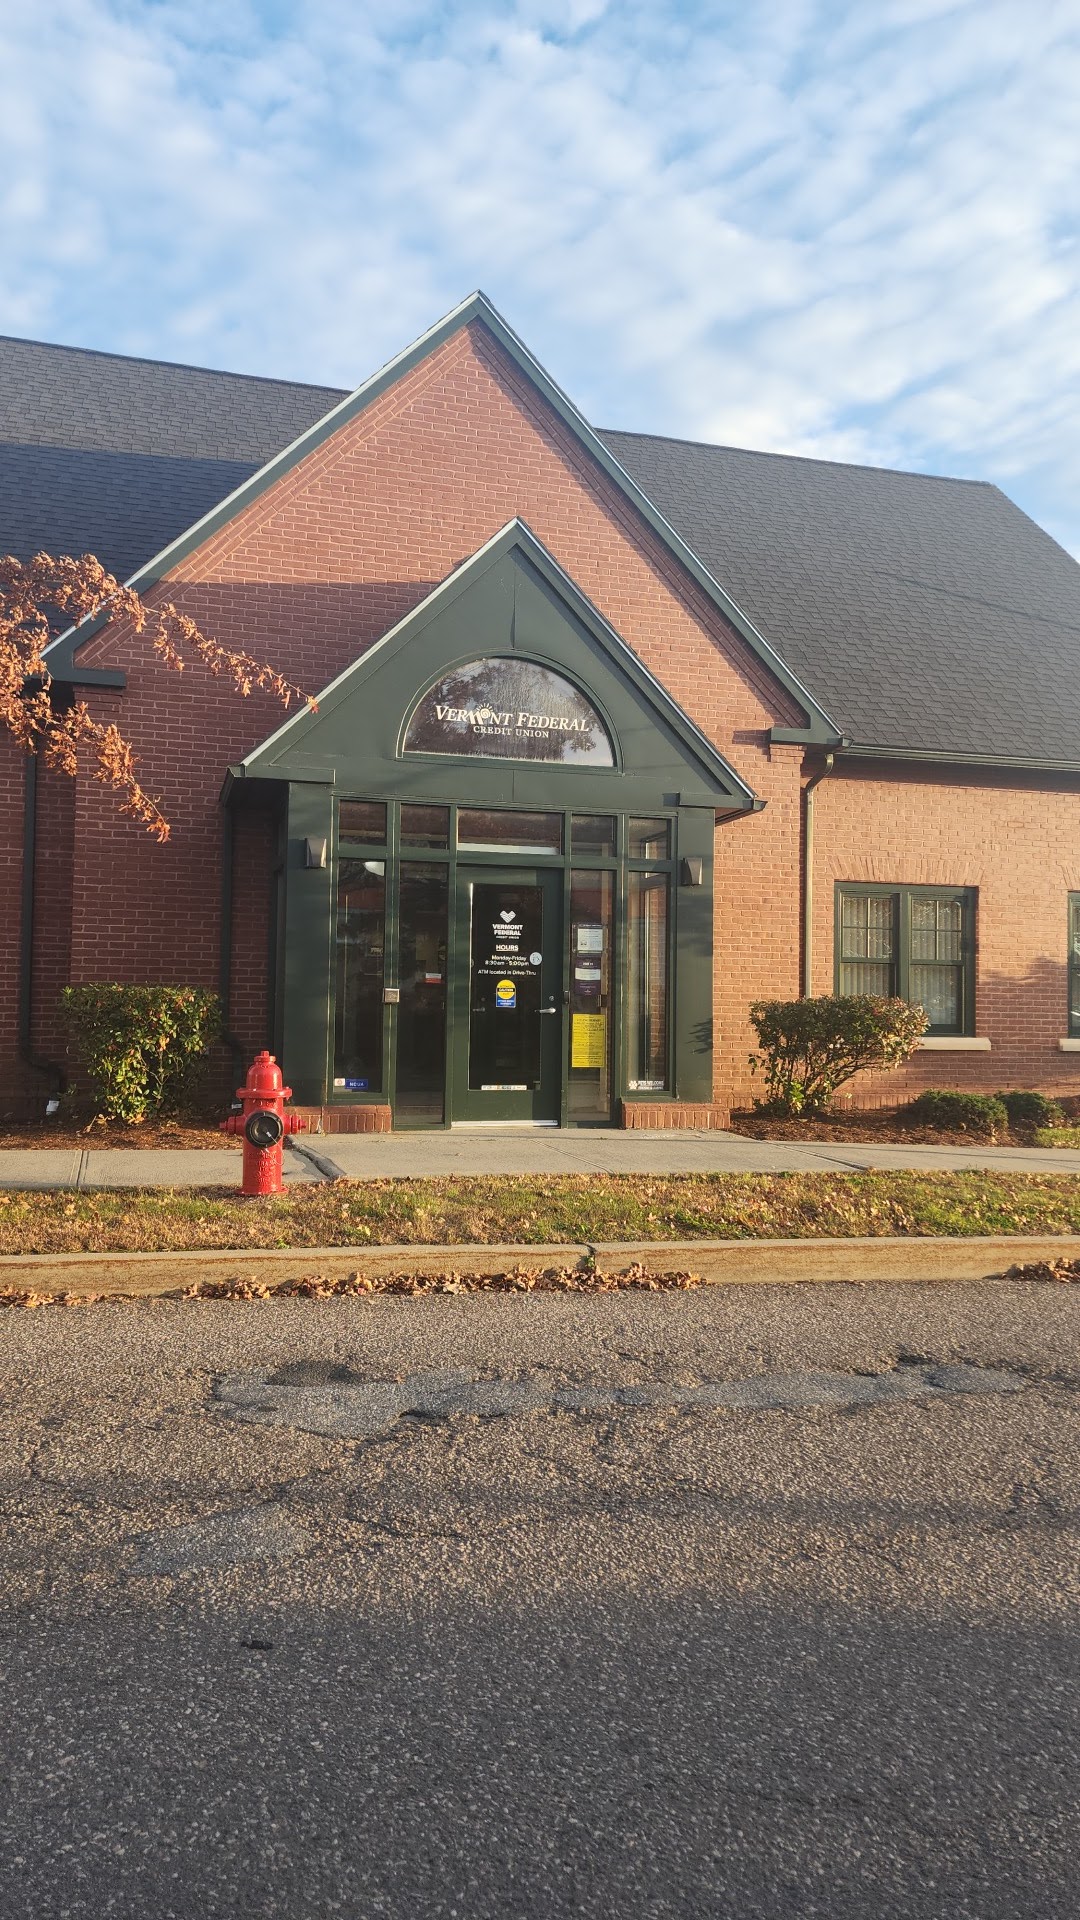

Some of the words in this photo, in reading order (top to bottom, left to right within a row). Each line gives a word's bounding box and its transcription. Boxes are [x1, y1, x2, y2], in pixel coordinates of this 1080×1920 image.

[435, 703, 513, 726] VERMONT
[516, 712, 589, 731] FEDERAL
[473, 726, 512, 736] CREDIT
[516, 729, 549, 739] UNION
